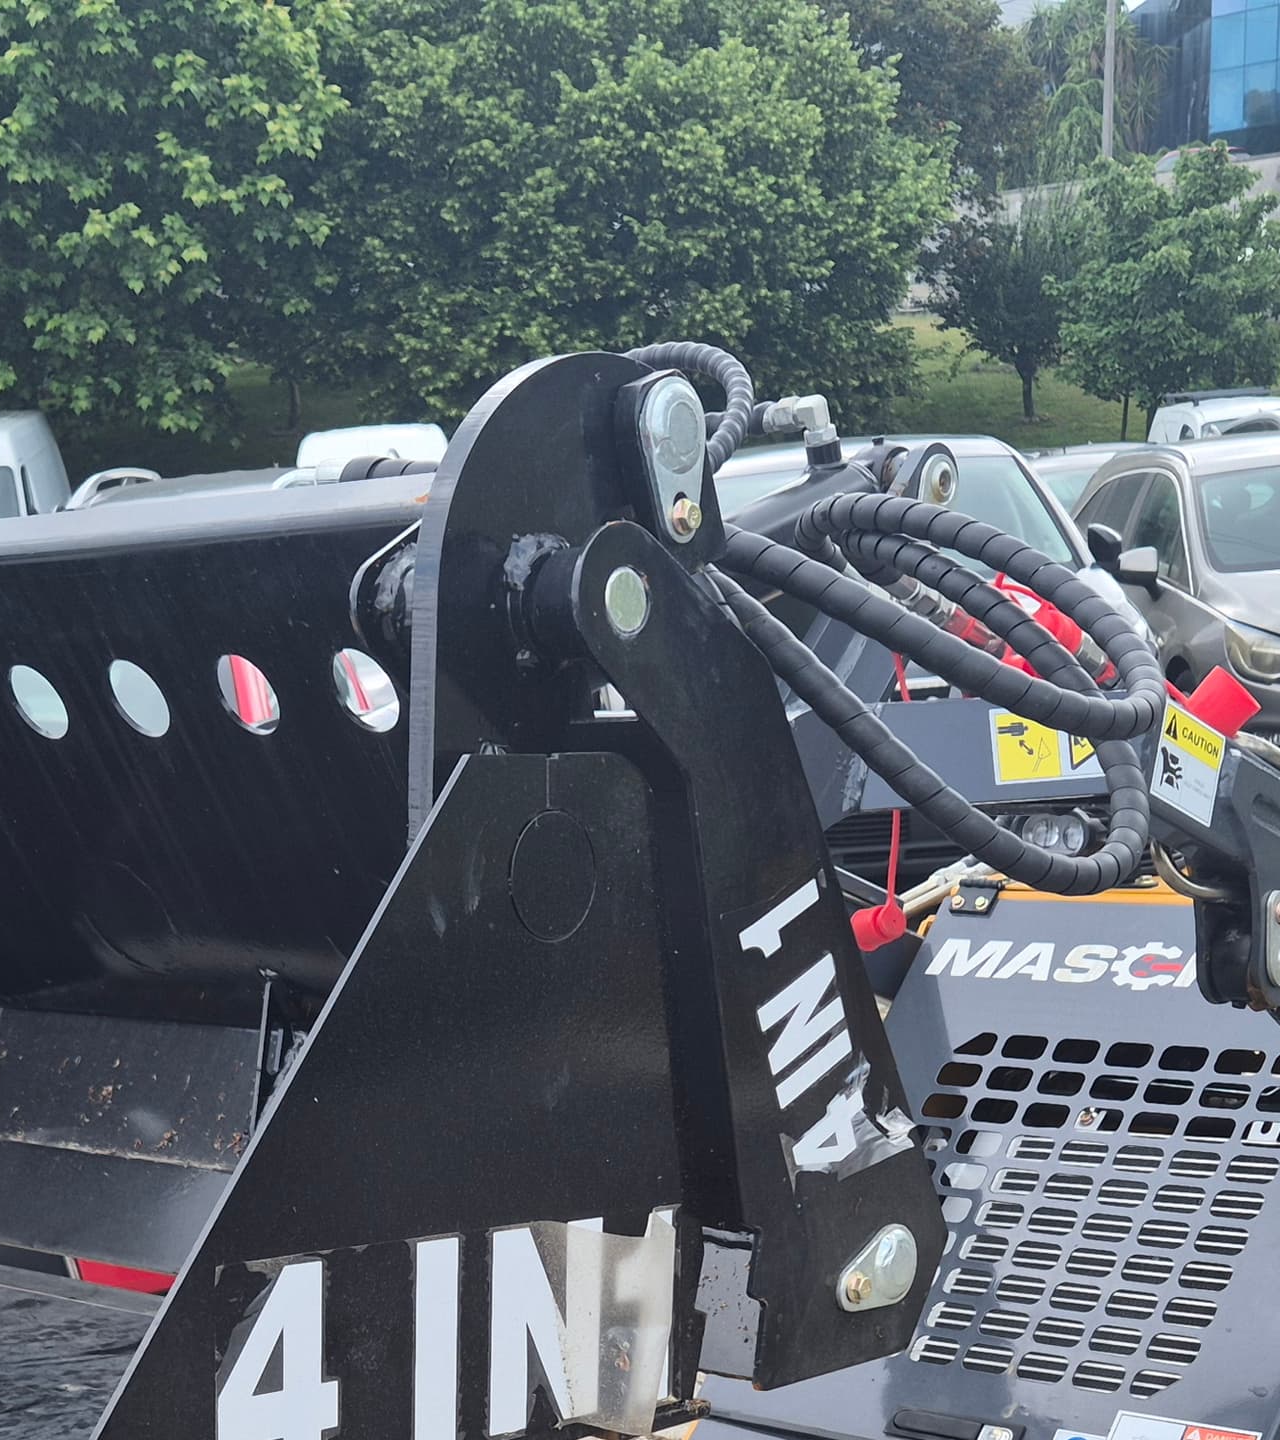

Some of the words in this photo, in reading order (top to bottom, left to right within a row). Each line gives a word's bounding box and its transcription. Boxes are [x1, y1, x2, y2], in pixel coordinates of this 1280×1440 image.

[1181, 727, 1219, 759] CAUTION
[738, 878, 820, 959] 1
[756, 953, 853, 1110] IN
